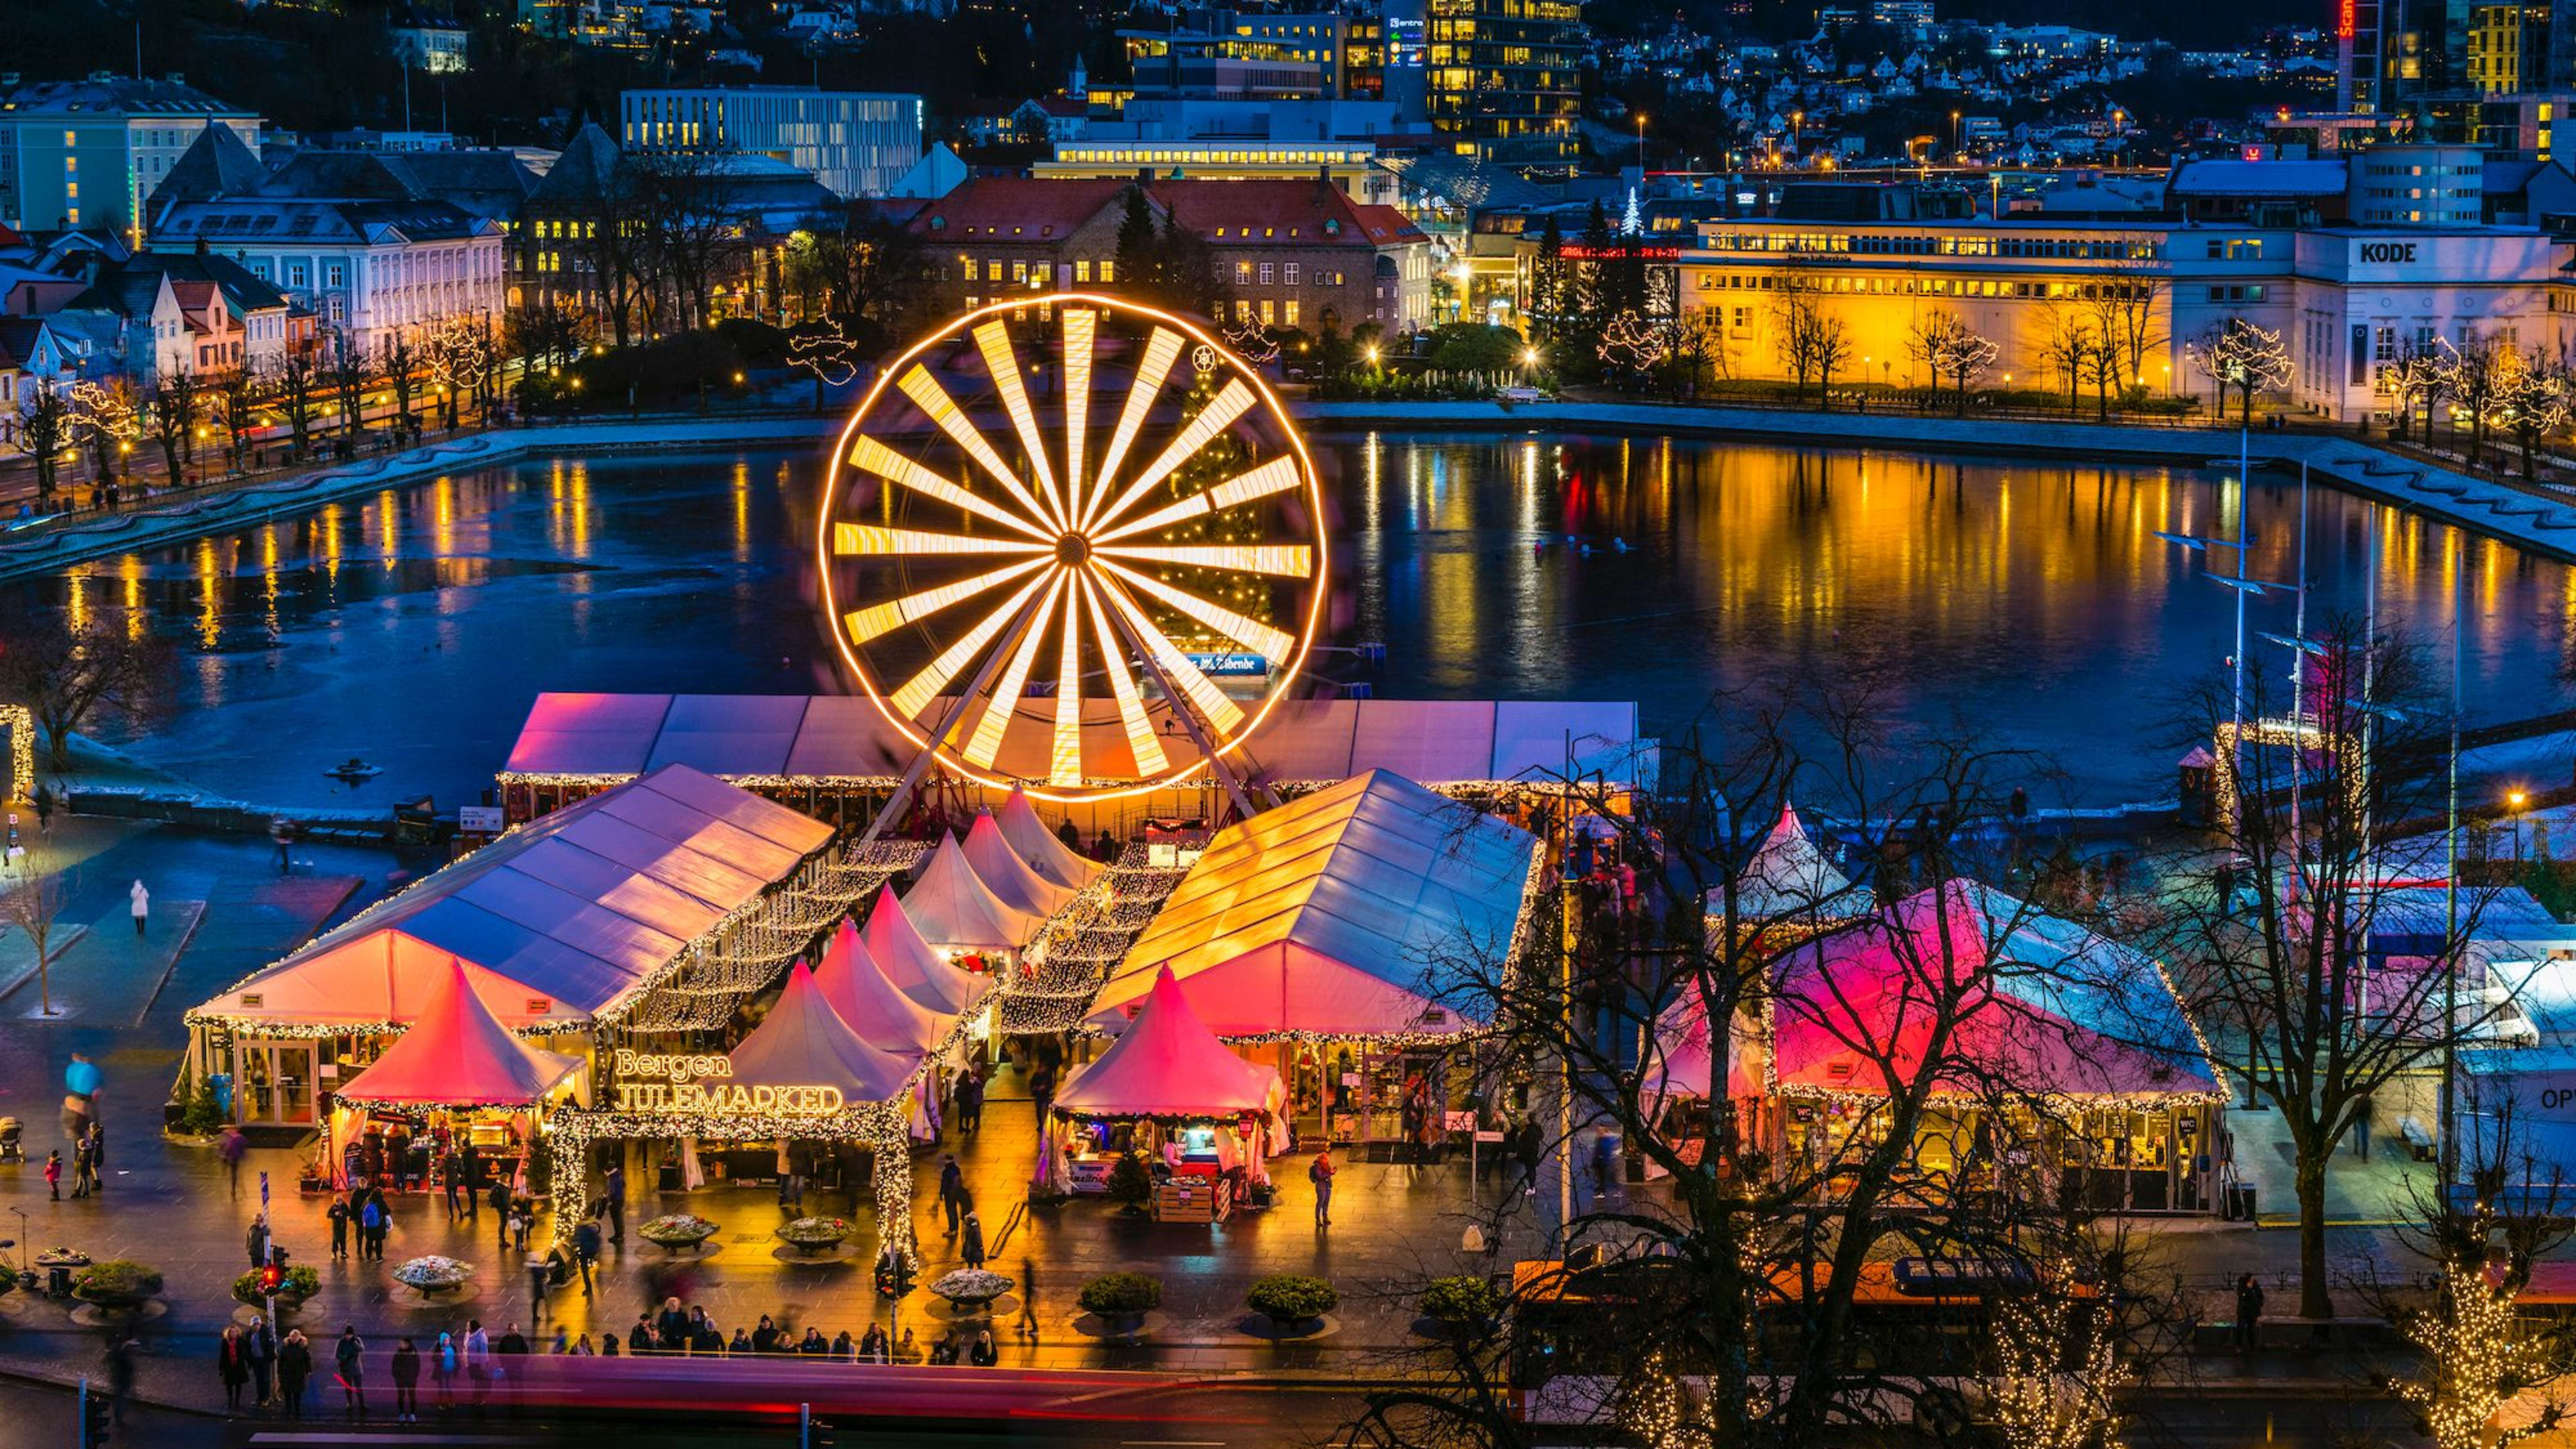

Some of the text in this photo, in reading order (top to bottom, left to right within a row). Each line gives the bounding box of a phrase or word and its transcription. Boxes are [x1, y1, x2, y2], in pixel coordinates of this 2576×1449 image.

[2361, 244, 2416, 262] KODE
[615, 1049, 733, 1083] Bergen
[614, 1083, 843, 1117] JULEMARKED
[2541, 1089, 2576, 1110] OP
[1796, 1108, 1811, 1116] WC
[2180, 1120, 2196, 1128] WC
